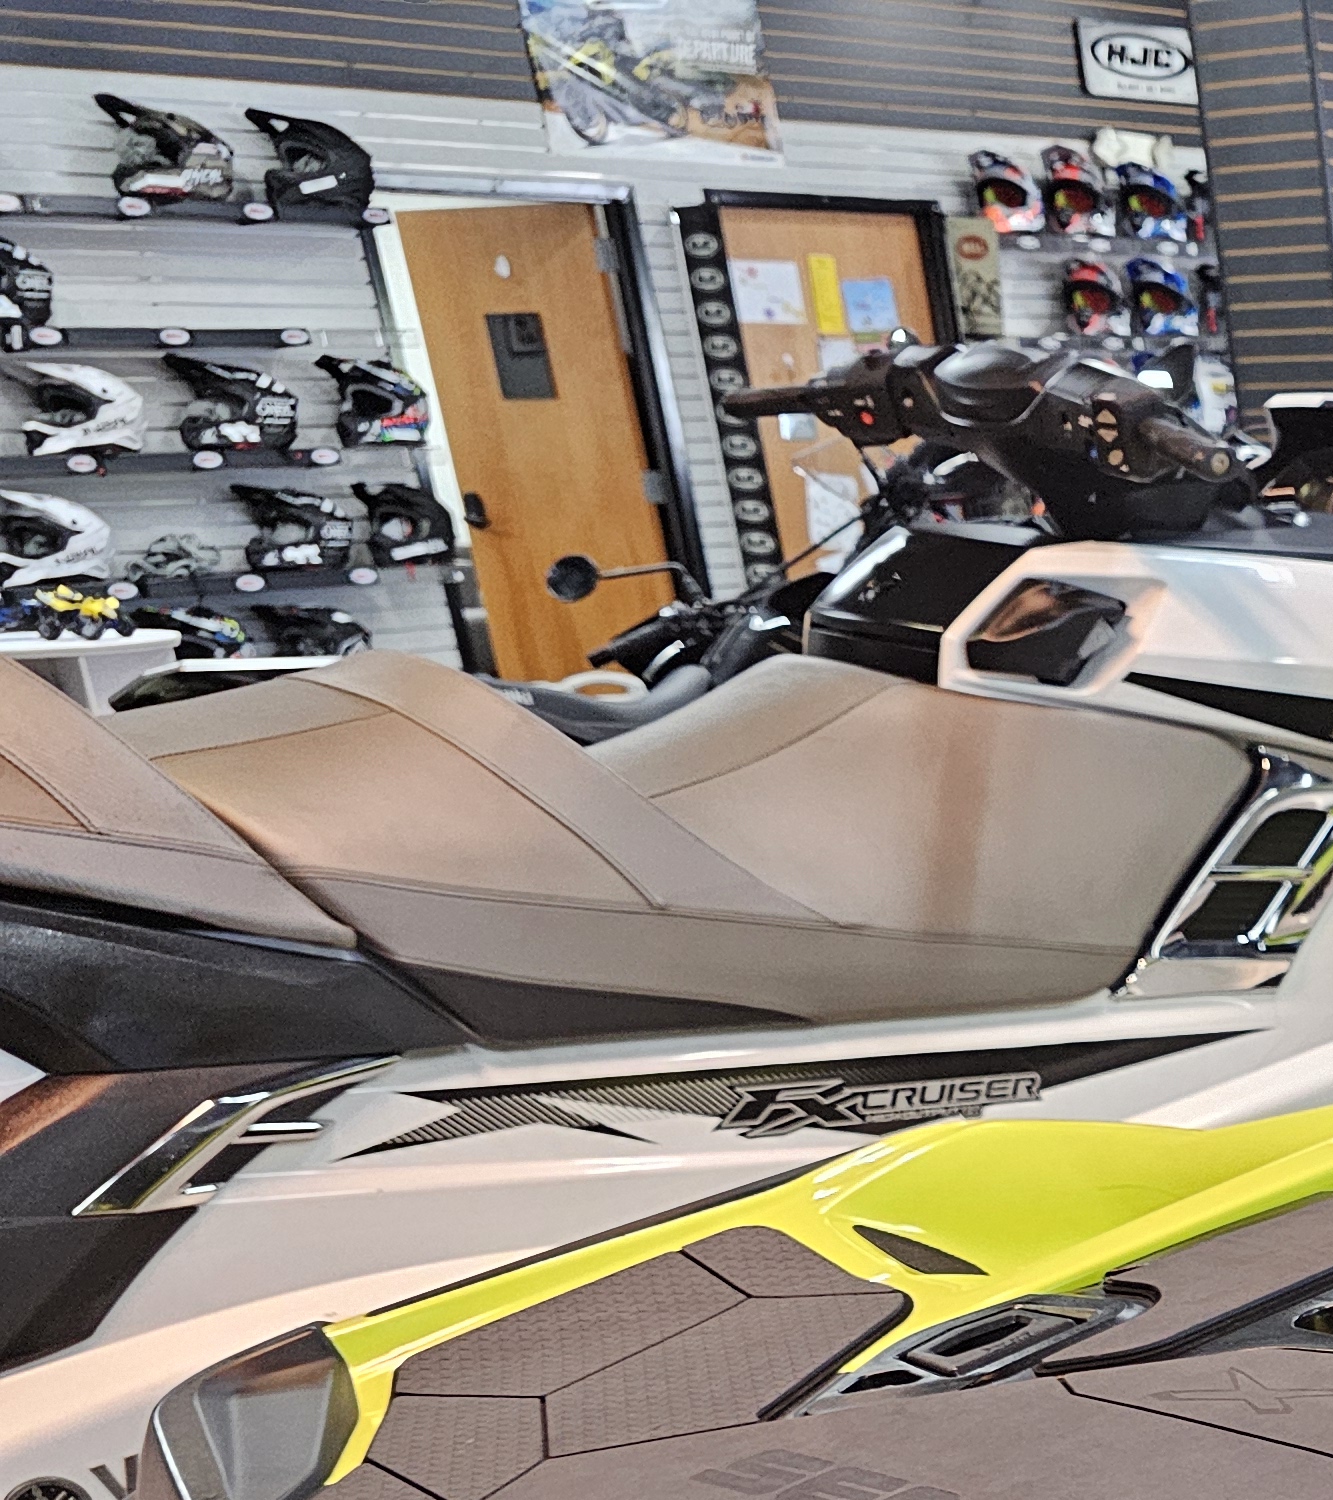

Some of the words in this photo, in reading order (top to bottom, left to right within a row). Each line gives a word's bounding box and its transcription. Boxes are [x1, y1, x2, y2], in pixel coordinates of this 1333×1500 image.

[1108, 44, 1171, 68] HJC
[717, 1078, 866, 1138] FX
[863, 1077, 1041, 1110] CRUISER
